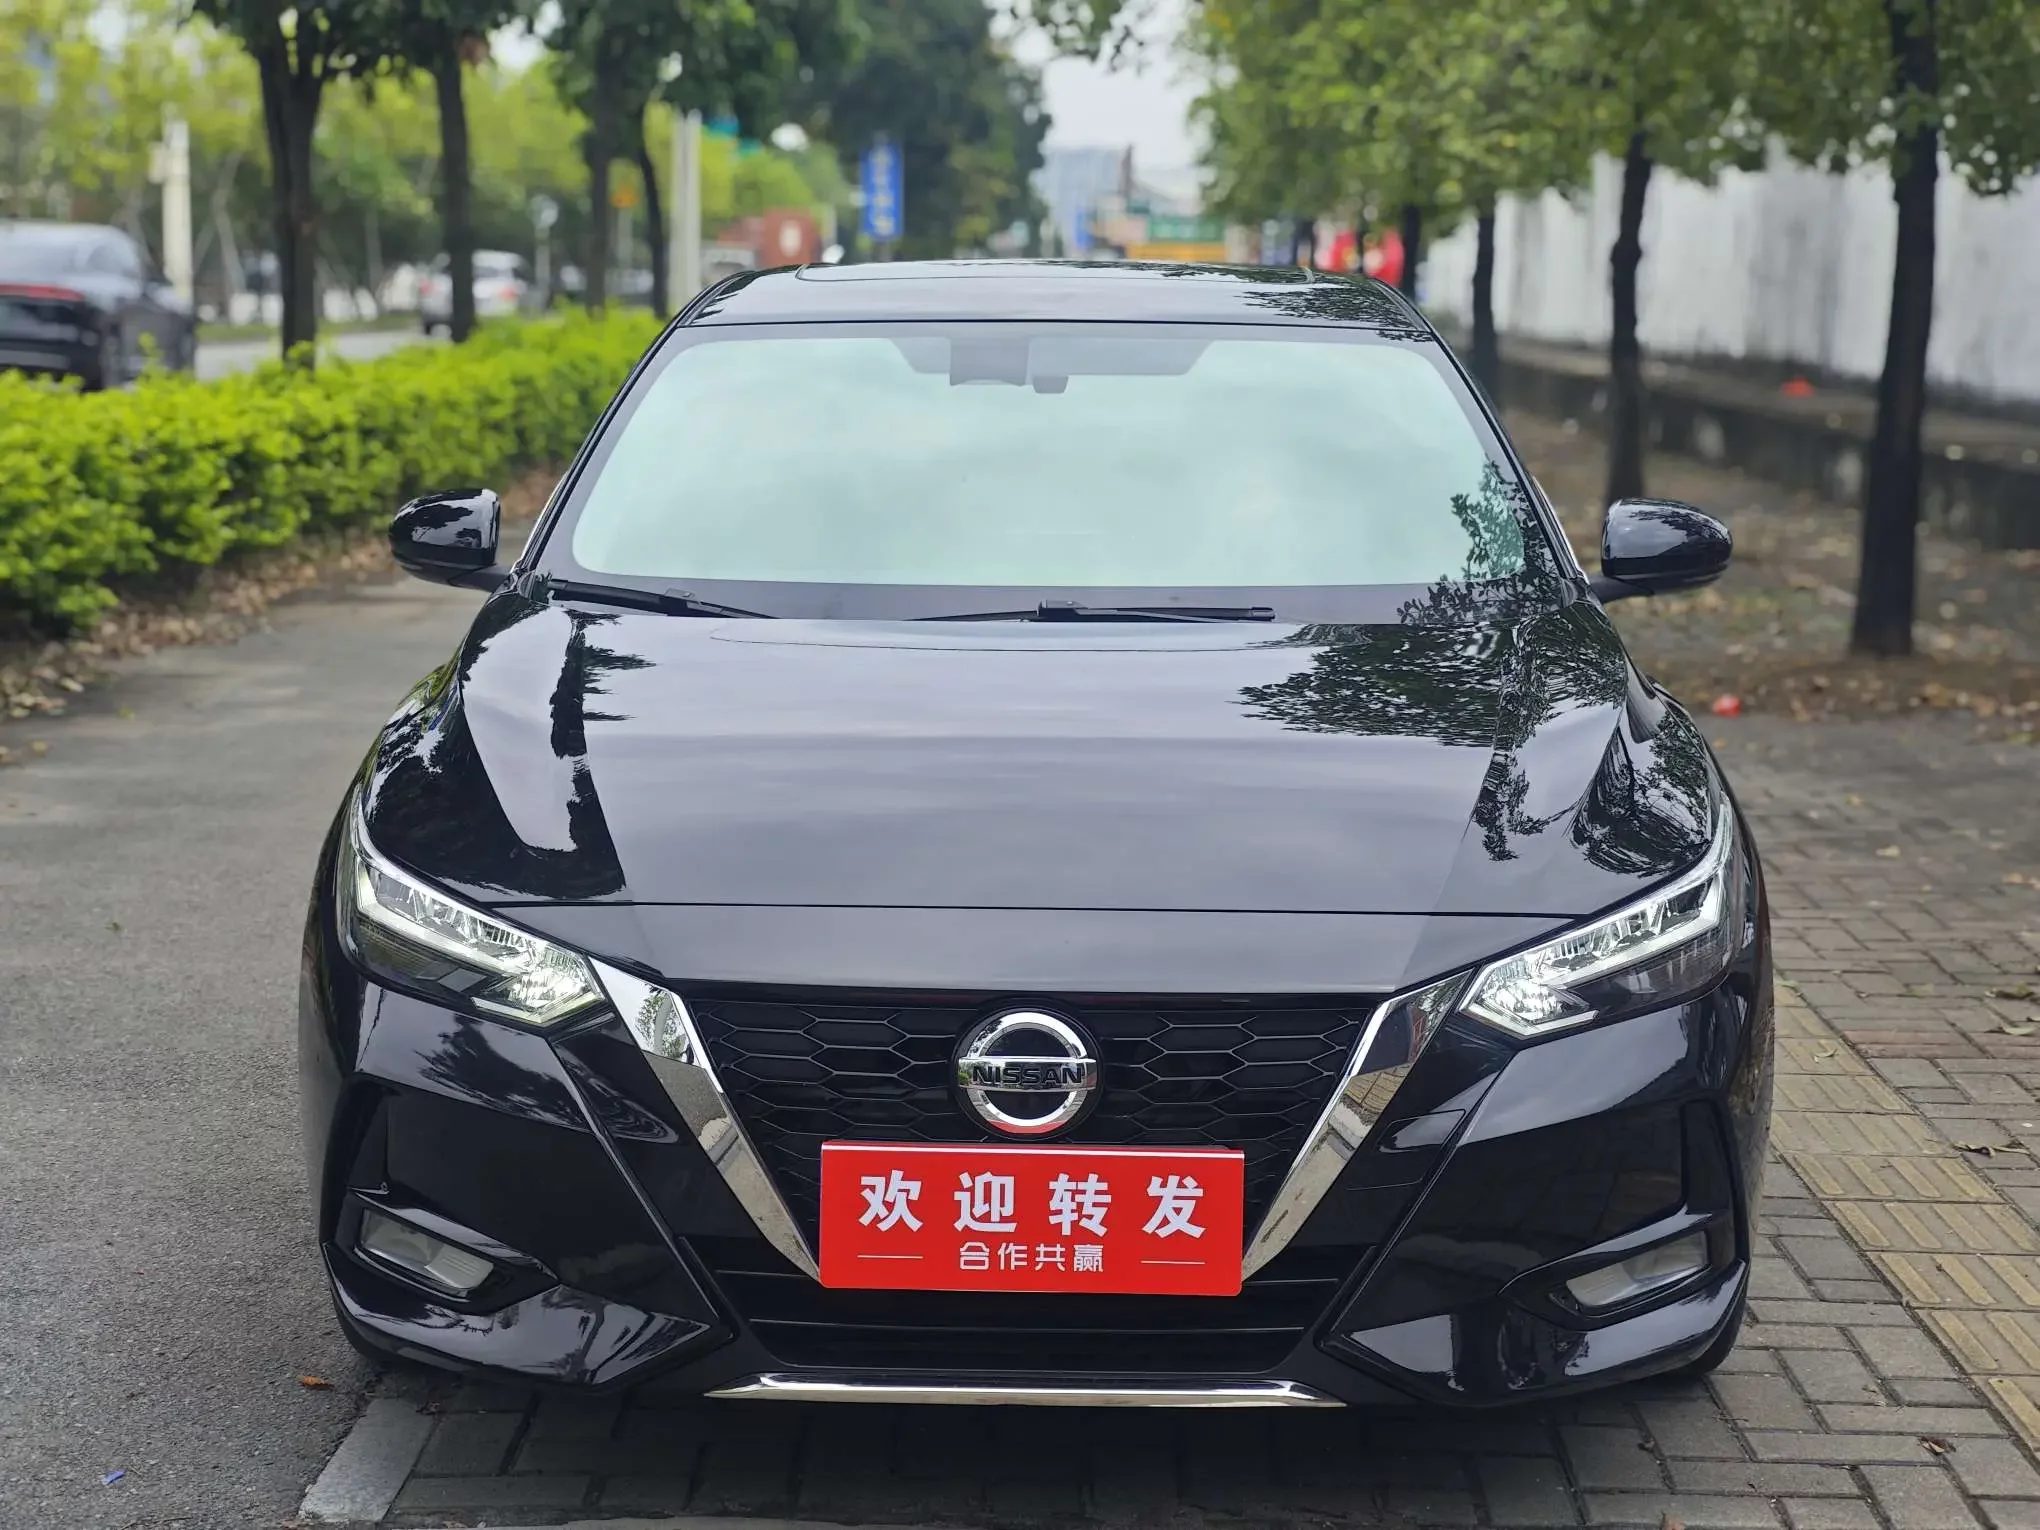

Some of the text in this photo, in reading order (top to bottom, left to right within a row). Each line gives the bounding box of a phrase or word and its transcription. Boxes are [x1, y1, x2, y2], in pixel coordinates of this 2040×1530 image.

[972, 1066, 1082, 1084] NISSAN
[859, 1169, 1207, 1239] 欢迎转发
[959, 1241, 1105, 1273] 合作共赢
